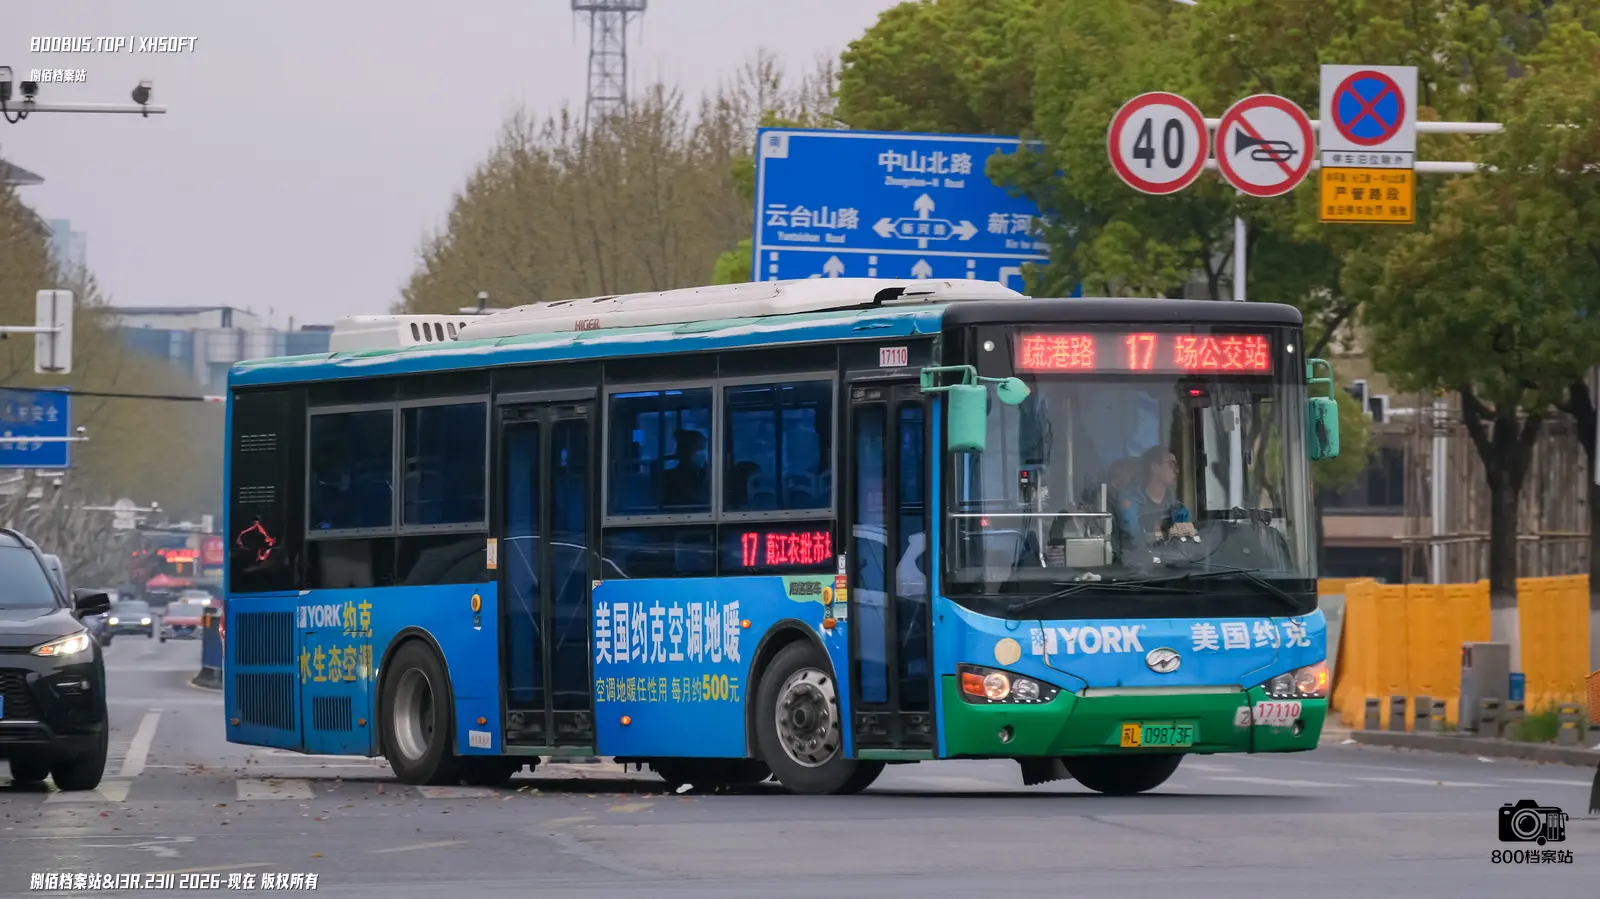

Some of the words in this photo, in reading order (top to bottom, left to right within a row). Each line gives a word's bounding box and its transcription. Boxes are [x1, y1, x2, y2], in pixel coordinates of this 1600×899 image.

[1132, 117, 1185, 169] 40
[878, 150, 973, 175] 中山北路
[1334, 187, 1401, 201] 严管路段
[765, 204, 860, 229] 云台山路
[575, 318, 600, 331] HIGER
[881, 349, 907, 364] 17110
[1023, 336, 1095, 368] 疏港路
[1126, 335, 1157, 369] 17
[1174, 336, 1269, 368] 场公交站
[741, 532, 758, 566] 17
[307, 604, 341, 628] YORK
[343, 599, 373, 638] 约克
[596, 600, 740, 664] 美国约克空调地暖
[1057, 625, 1144, 654] YORK
[1191, 620, 1311, 652] 美国约克
[297, 645, 373, 684] 水生态空调
[596, 676, 667, 702] 空调地暖任性用
[671, 674, 740, 702] 每月约500元
[1258, 703, 1300, 719] 17110
